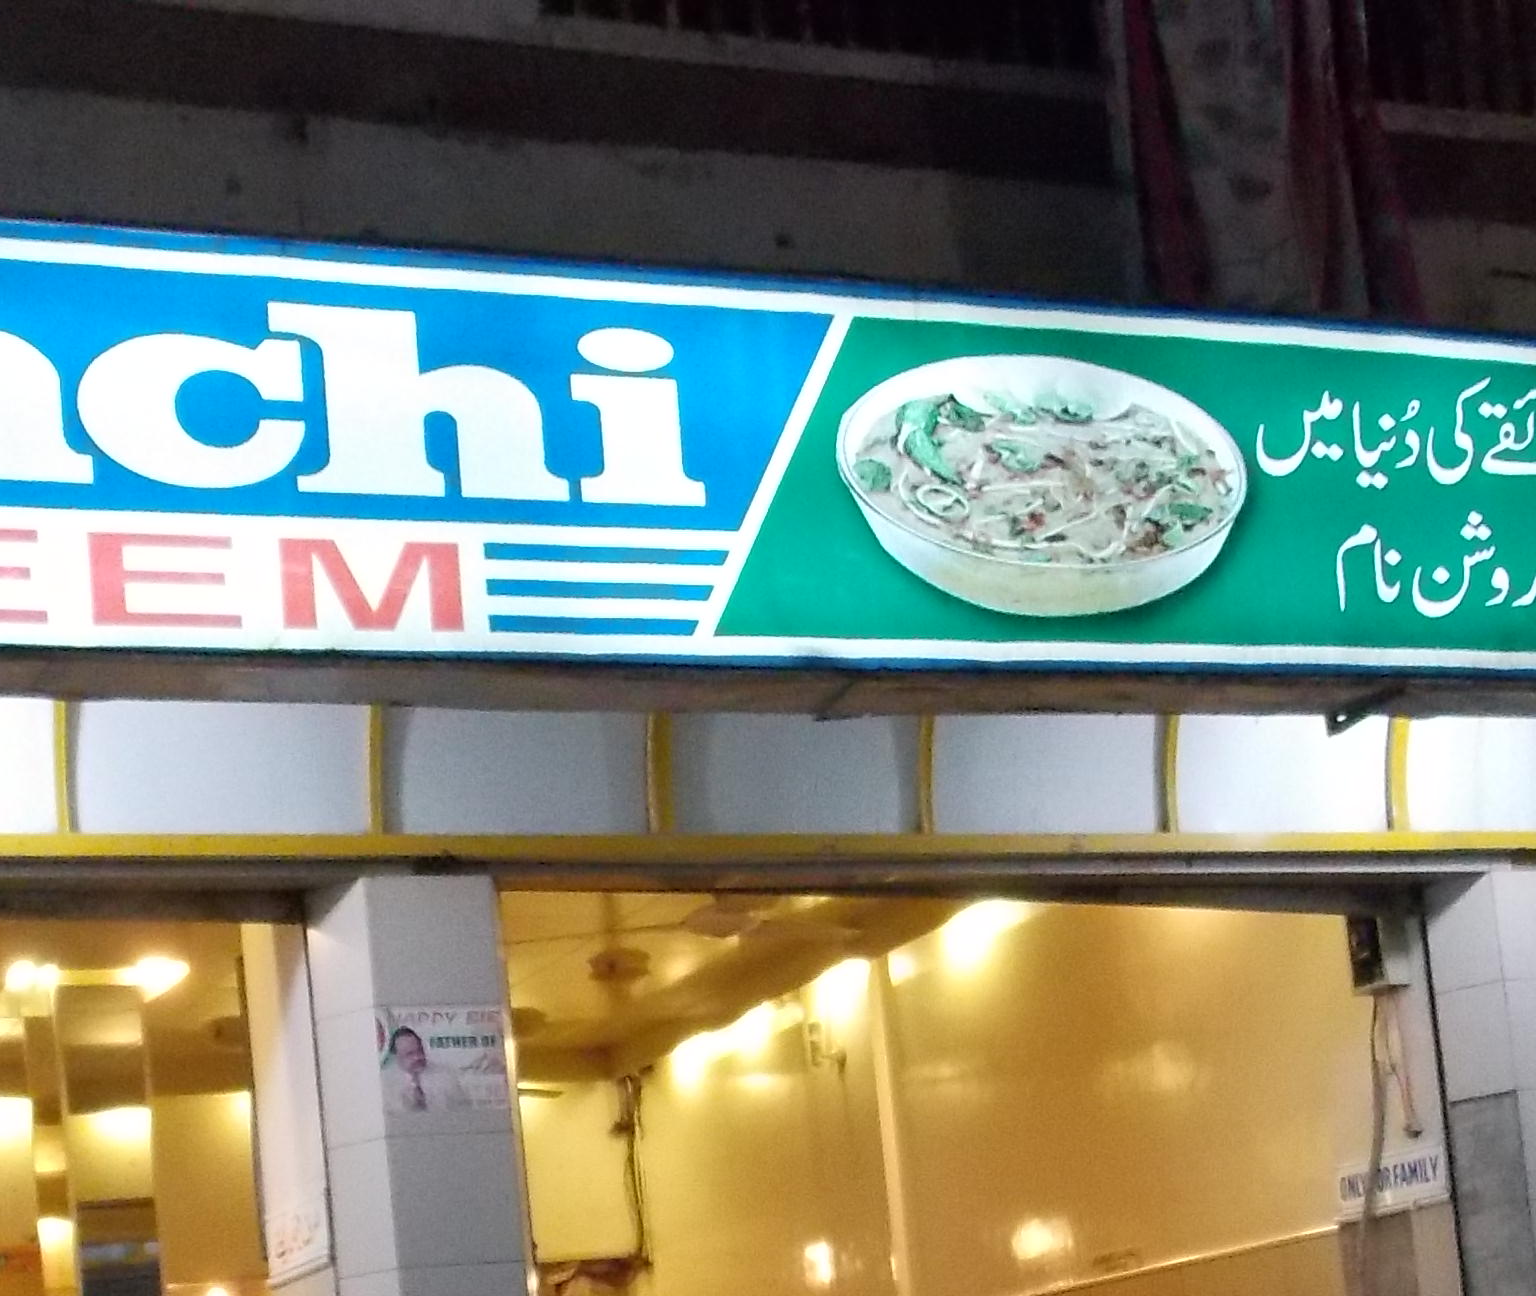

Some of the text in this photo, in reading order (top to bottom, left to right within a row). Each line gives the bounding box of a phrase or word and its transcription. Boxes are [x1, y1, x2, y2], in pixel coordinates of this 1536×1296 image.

[1256, 390, 1344, 477] میں
[1426, 376, 1492, 485] کی
[1336, 523, 1402, 612] نام
[1393, 1154, 1441, 1187] FAMILY
